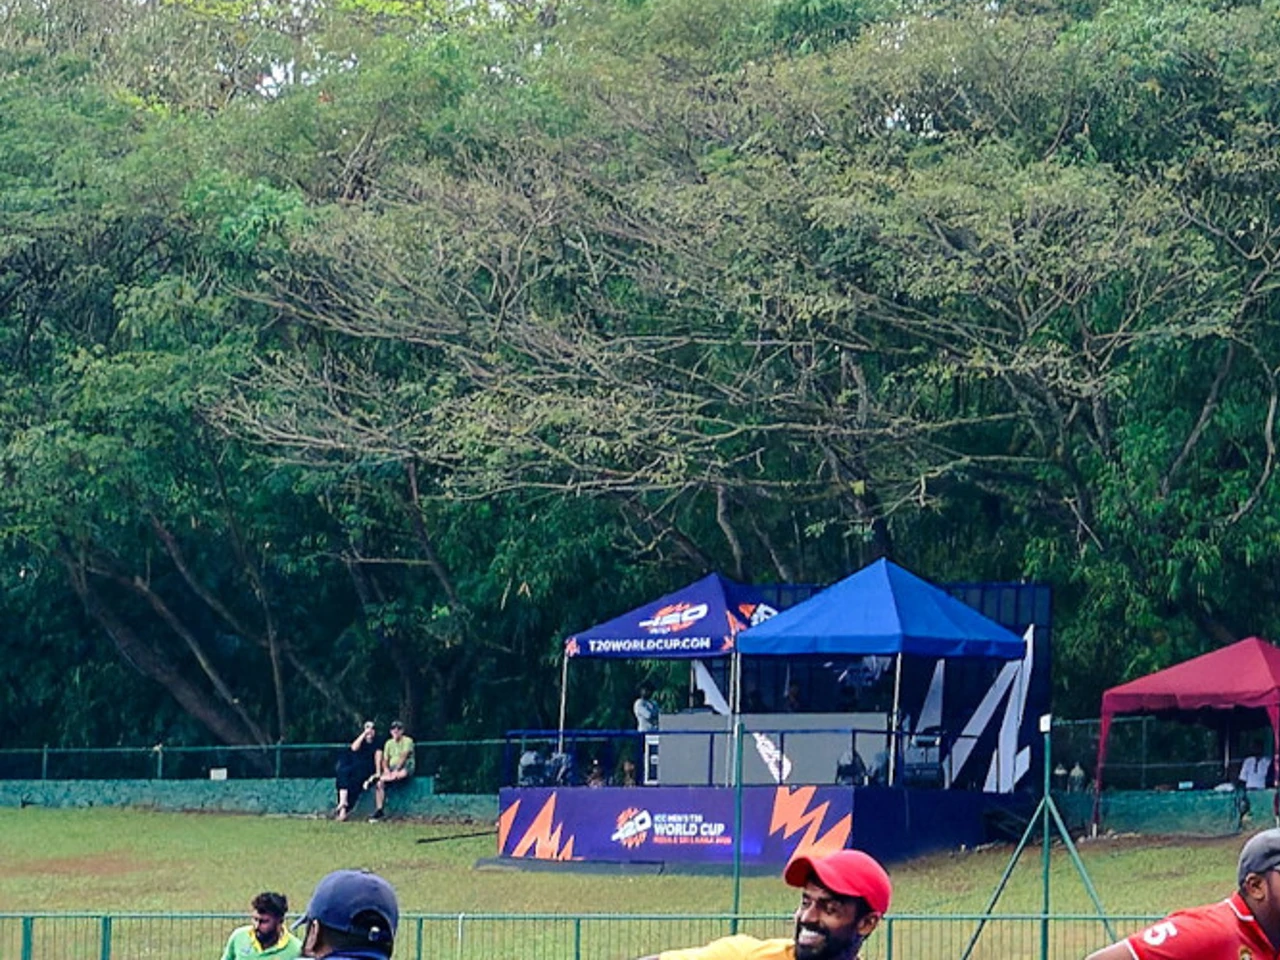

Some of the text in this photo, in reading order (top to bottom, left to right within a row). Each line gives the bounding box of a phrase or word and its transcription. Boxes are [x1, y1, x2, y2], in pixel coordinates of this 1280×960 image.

[588, 637, 711, 652] T20WORLDCUP.COM
[653, 823, 725, 836] WORLD CUP
